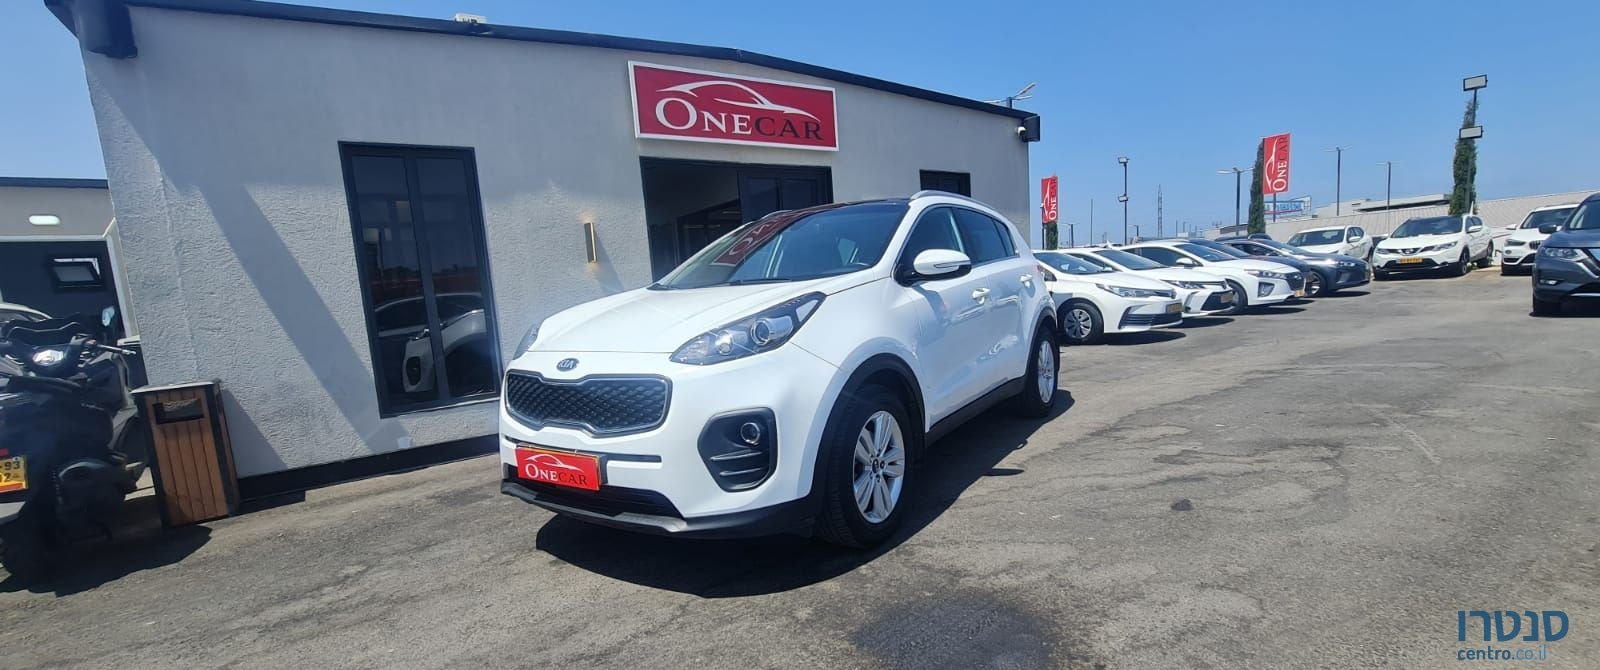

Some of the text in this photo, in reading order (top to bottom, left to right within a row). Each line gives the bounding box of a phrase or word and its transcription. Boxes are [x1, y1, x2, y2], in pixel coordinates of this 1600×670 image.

[656, 97, 823, 141] ONECAR
[558, 359, 575, 370] KIA
[525, 463, 588, 486] ONECAR
